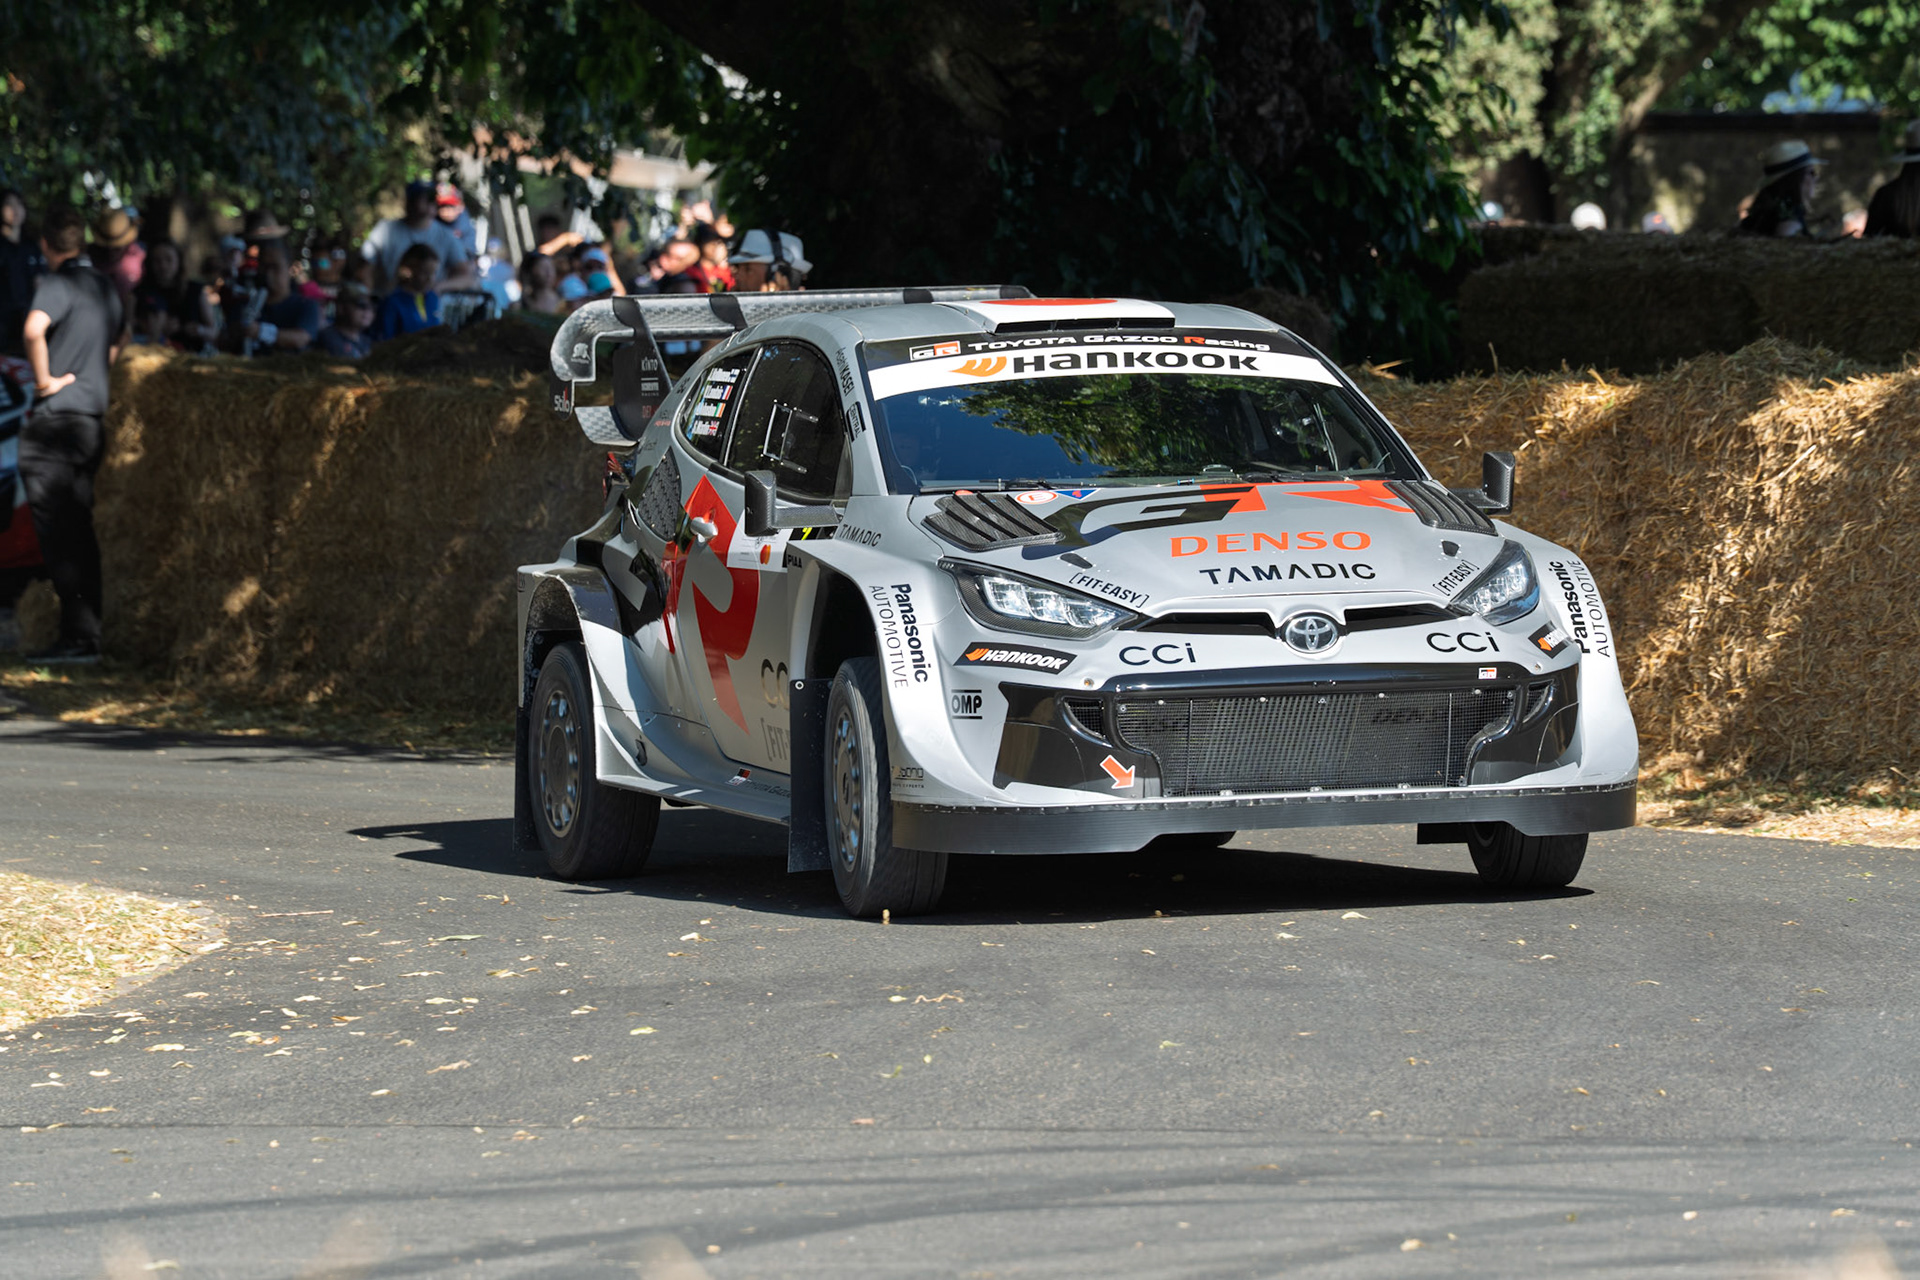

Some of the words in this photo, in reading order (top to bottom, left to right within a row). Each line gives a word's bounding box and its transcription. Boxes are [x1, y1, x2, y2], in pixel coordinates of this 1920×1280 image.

[968, 336, 1076, 350] TOYOTA
[1083, 335, 1178, 344] GAZOO
[839, 524, 881, 547] TAMADIC
[1171, 531, 1372, 557] DENSO
[1200, 563, 1376, 585] TAMADIC
[1548, 561, 1591, 654] Panasonic
[1567, 559, 1611, 658] AUTOMOTIVE
[869, 585, 909, 688] AUTOMOTIVE
[890, 583, 931, 683] Panasonic
[951, 695, 982, 714] OMP
